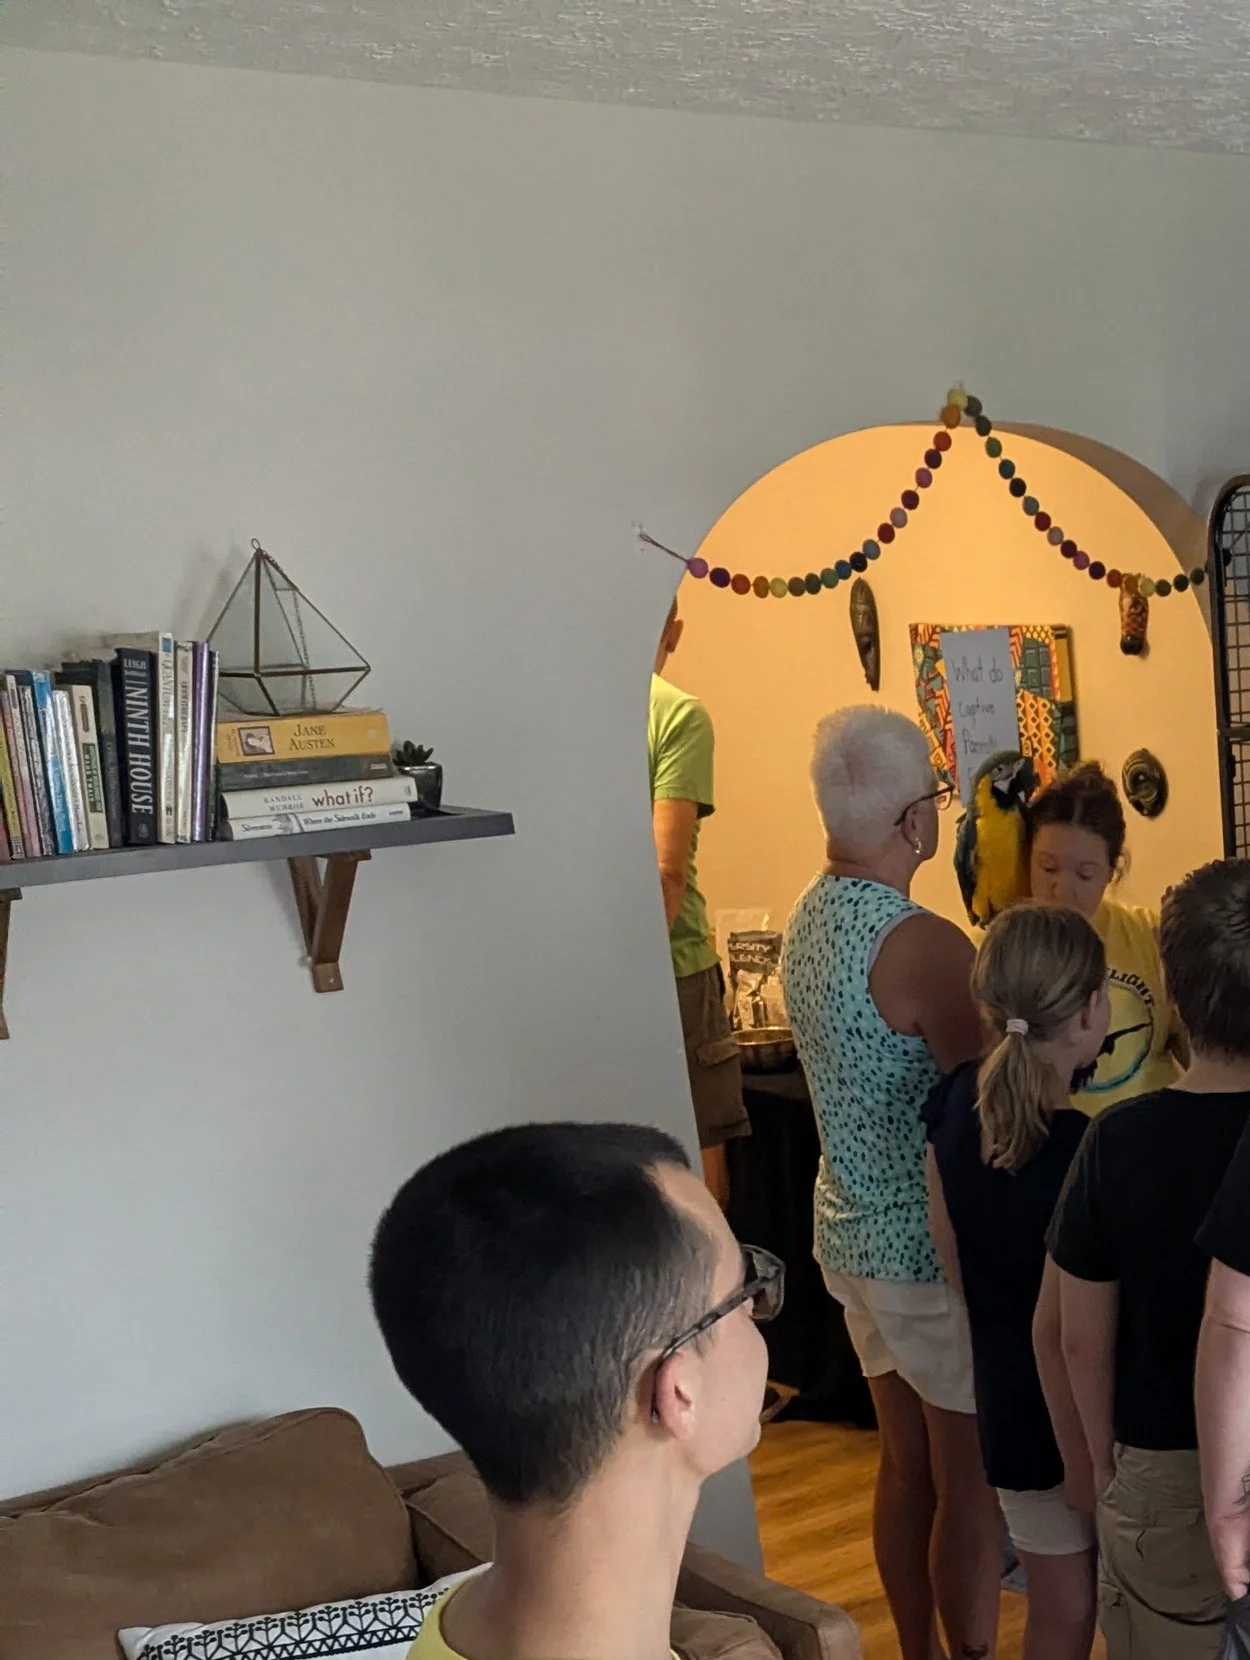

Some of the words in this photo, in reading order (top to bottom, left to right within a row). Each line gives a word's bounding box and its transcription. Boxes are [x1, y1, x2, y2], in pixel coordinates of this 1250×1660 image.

[951, 655, 983, 683] What
[989, 657, 1004, 683] do
[124, 685, 150, 747] NINTH
[289, 737, 335, 751] AUSTEN
[293, 724, 327, 737] JANE
[129, 753, 154, 815] HOUSE
[312, 789, 351, 808] what
[353, 785, 374, 803] if?
[1107, 967, 1155, 1007] LIGHT
